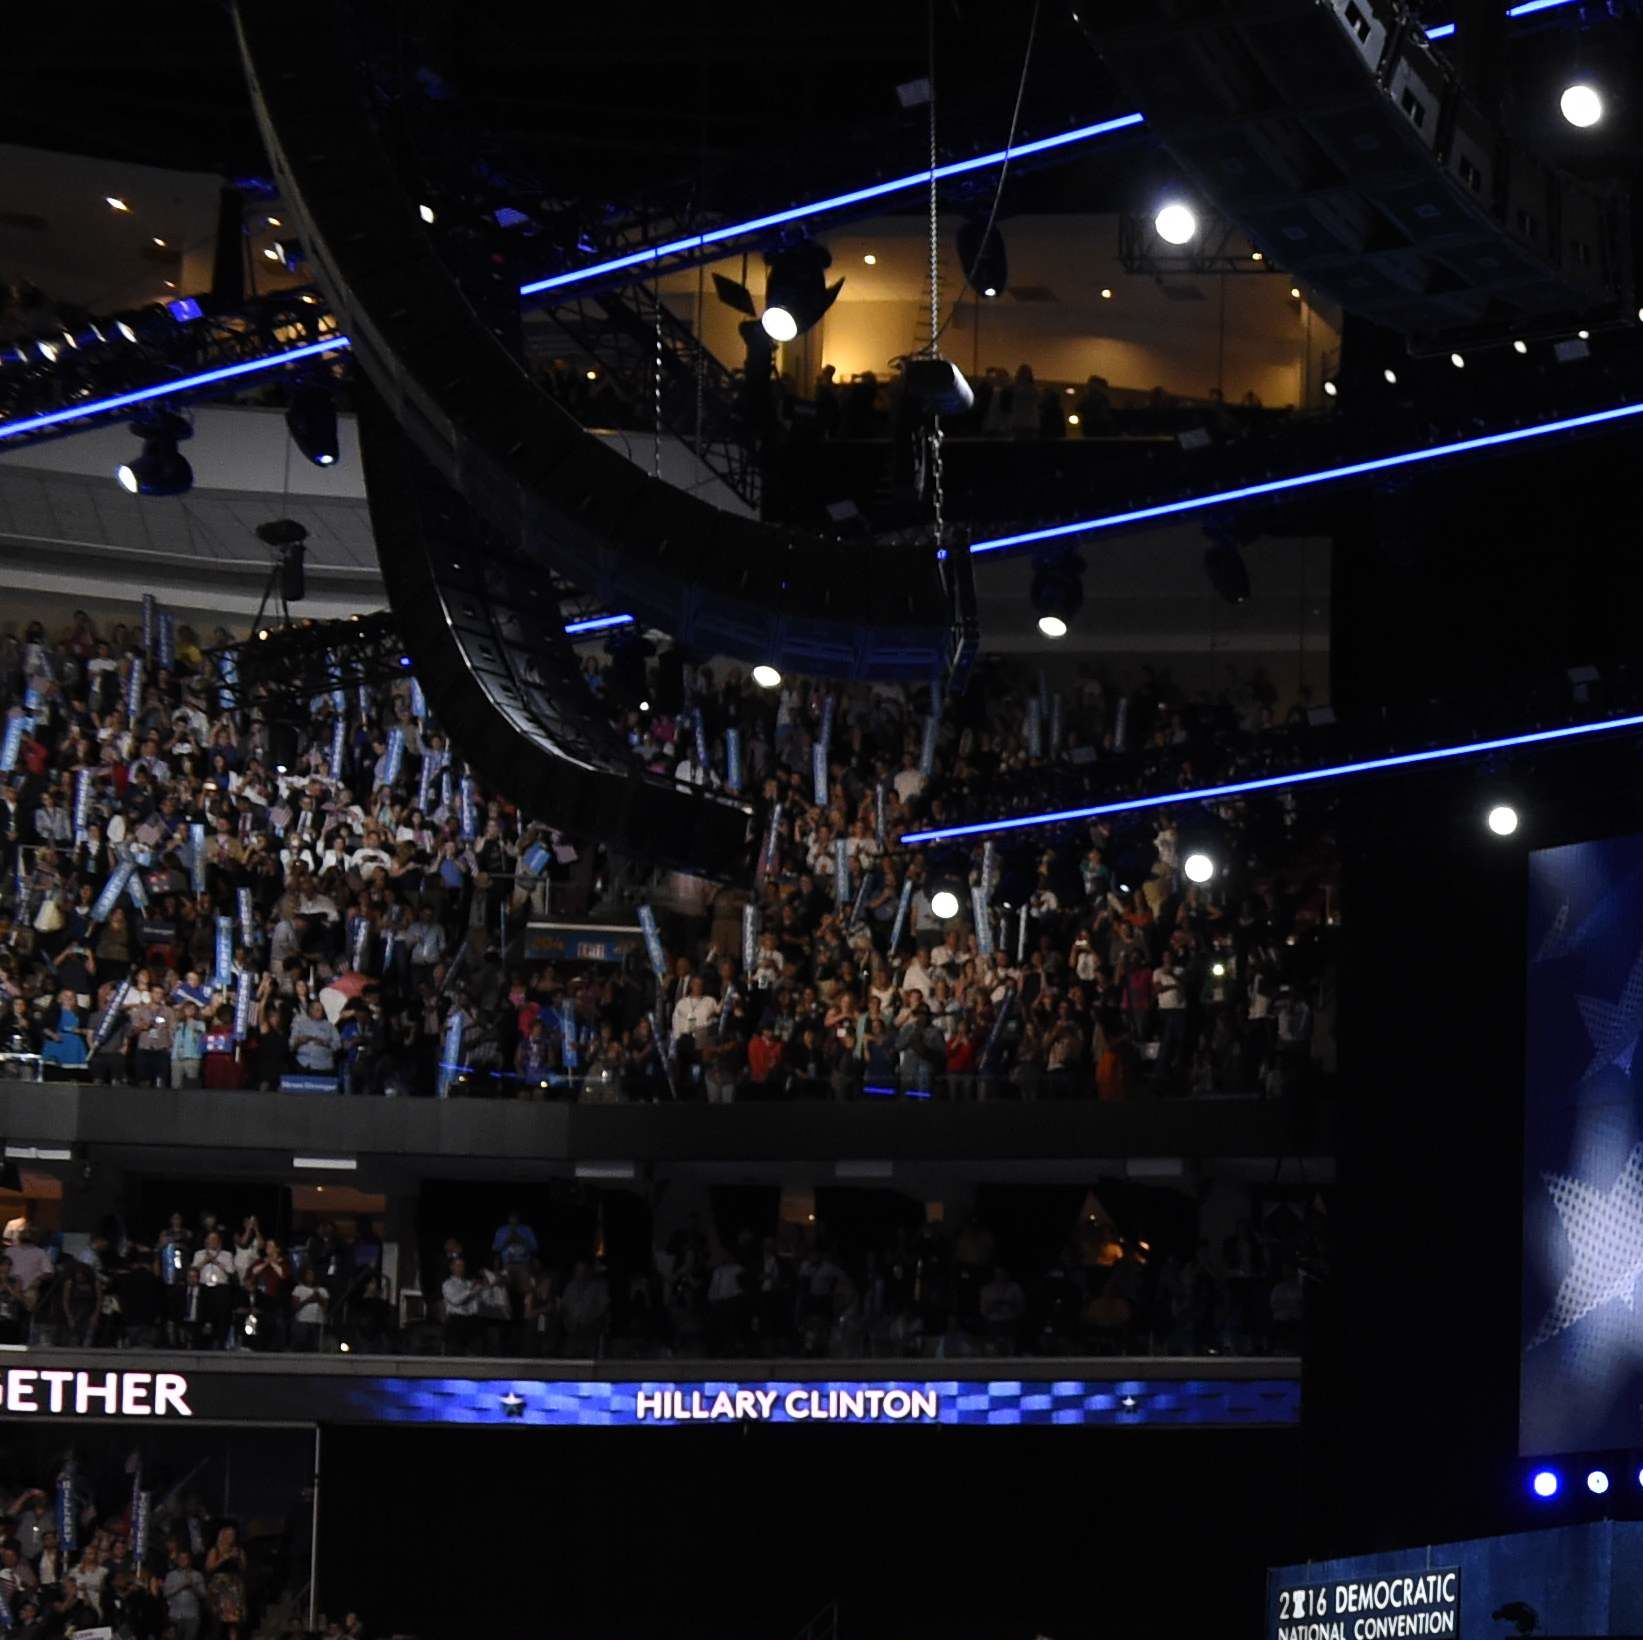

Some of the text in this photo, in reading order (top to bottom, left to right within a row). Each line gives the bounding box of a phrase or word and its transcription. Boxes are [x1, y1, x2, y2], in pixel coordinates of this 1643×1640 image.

[635, 1389, 938, 1420] HILLARY CLINTON
[1335, 1573, 1456, 1614] DEMOCRATIC
